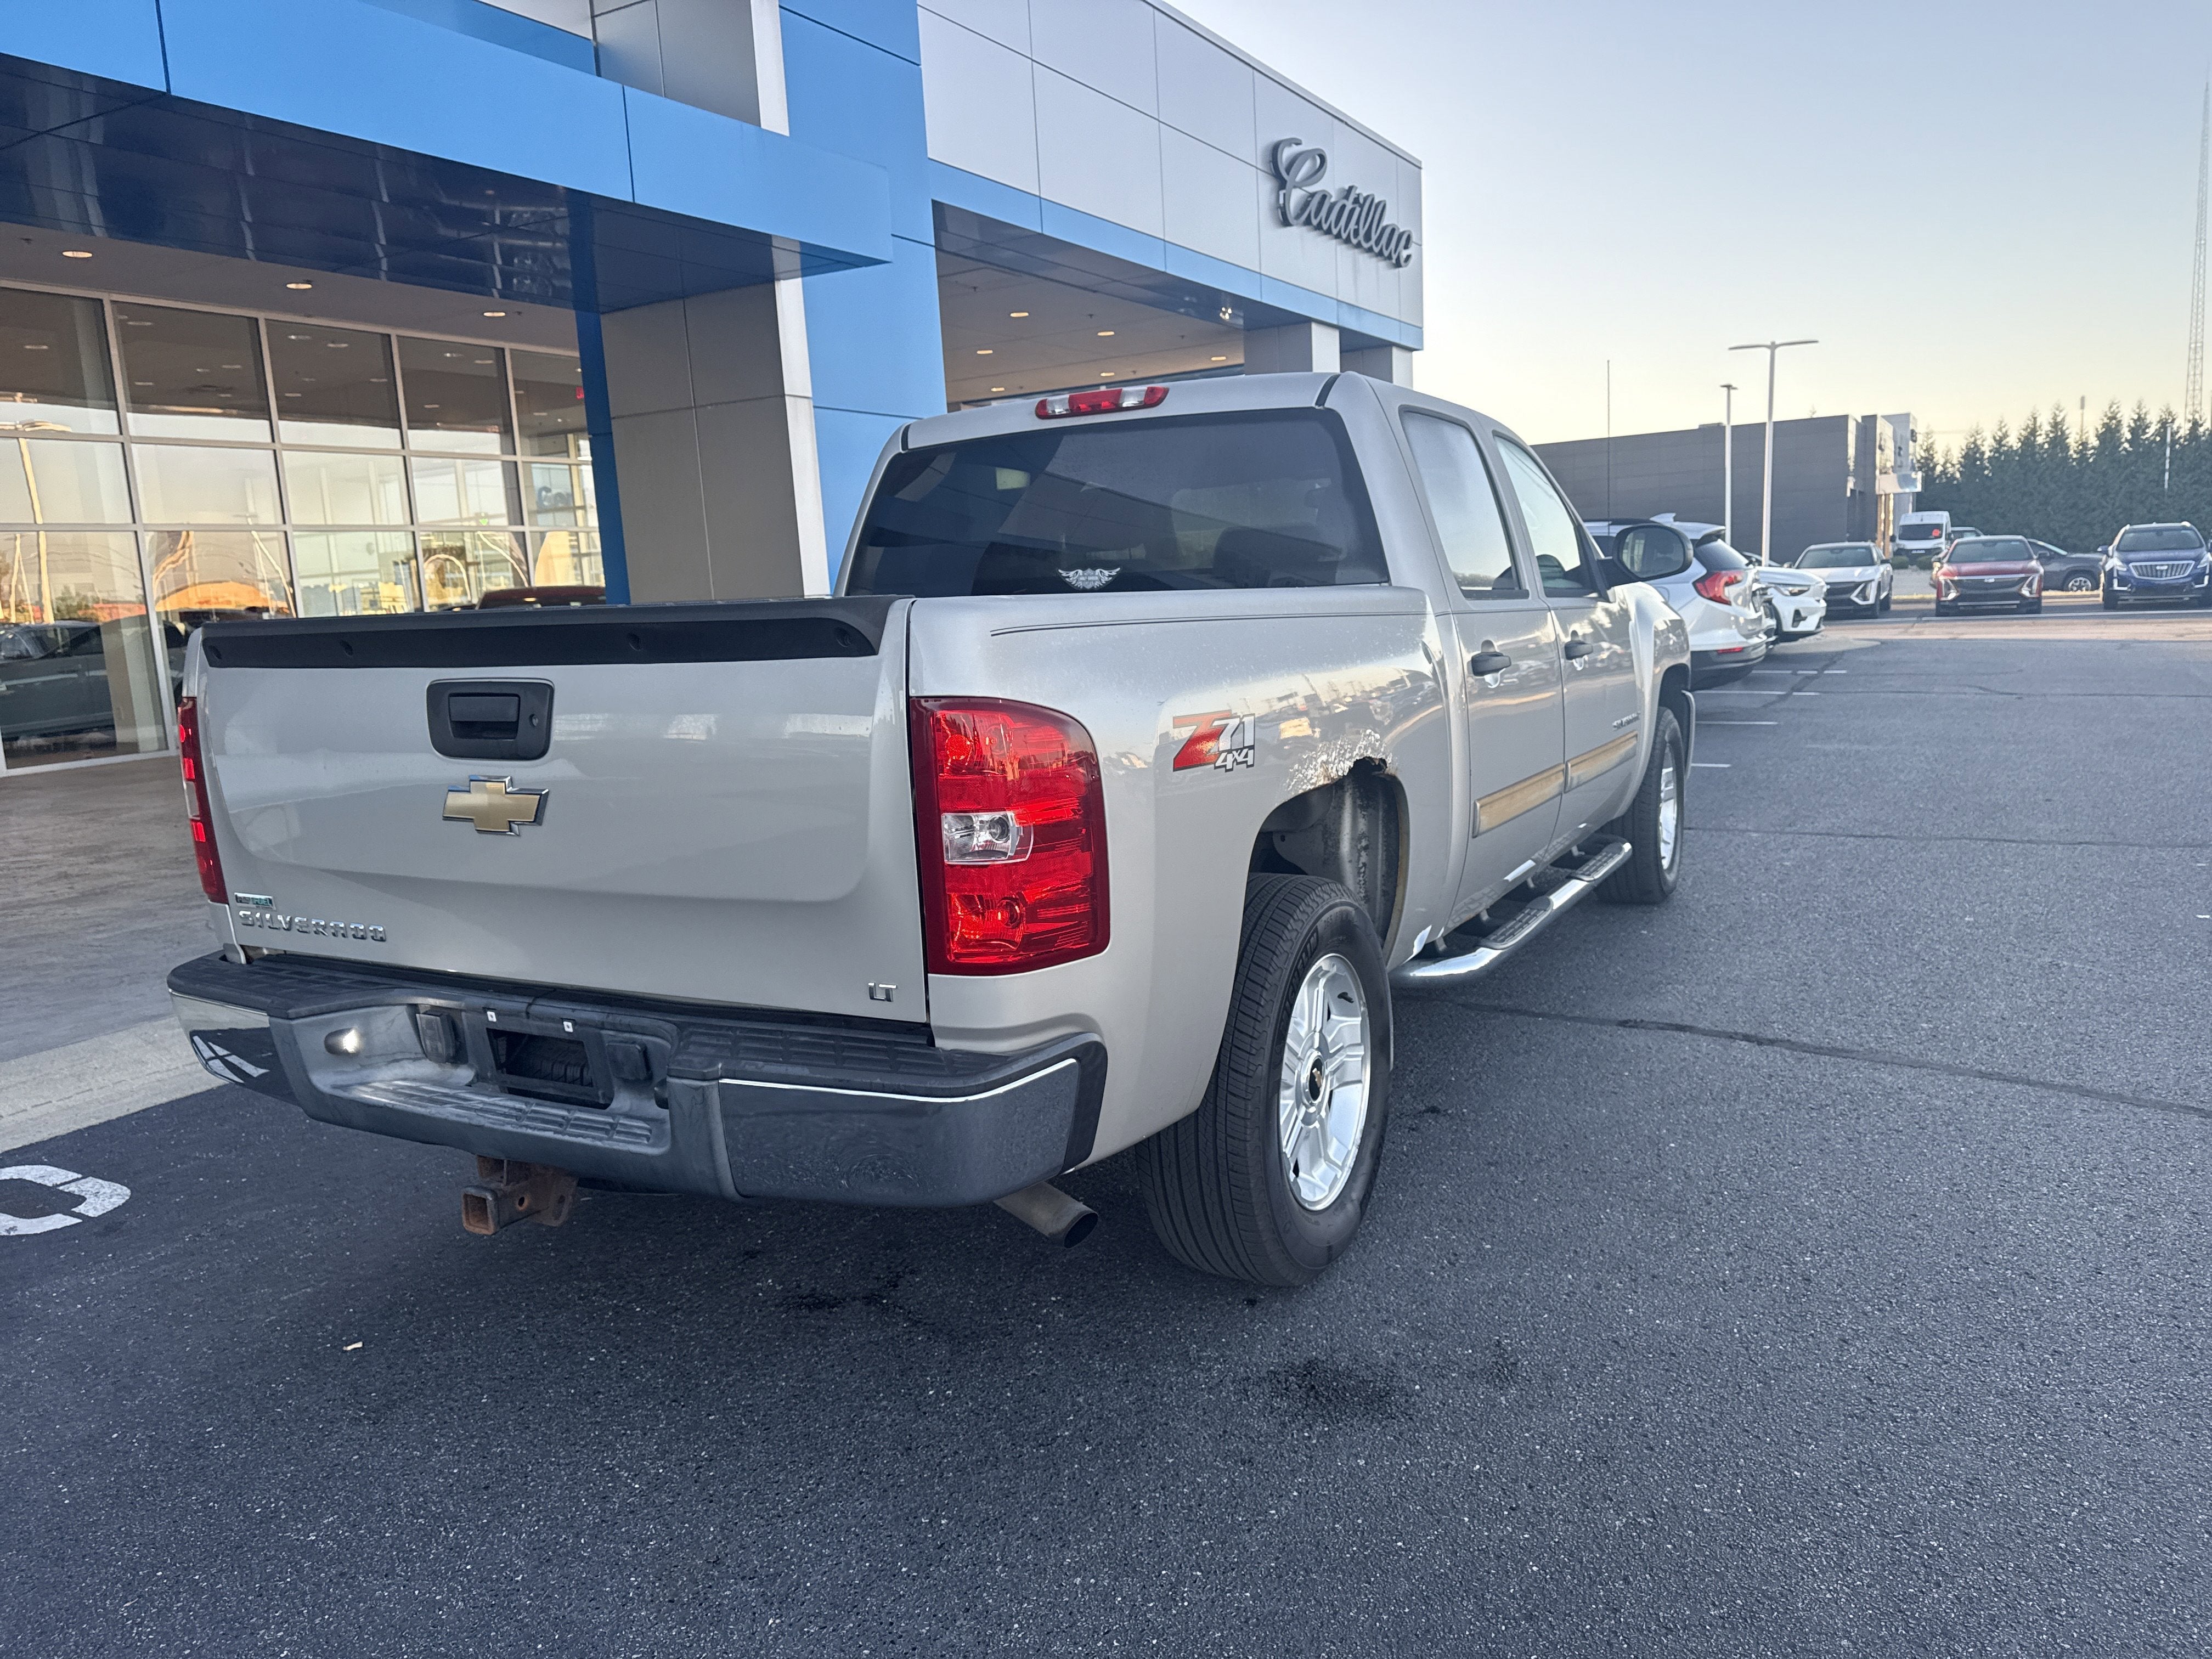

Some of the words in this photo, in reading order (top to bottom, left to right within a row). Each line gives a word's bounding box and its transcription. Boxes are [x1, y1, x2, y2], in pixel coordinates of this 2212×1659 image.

[1271, 137, 1413, 268] Cadillac
[1173, 709, 1255, 772] Z71
[239, 910, 386, 942] SILVERADO
[867, 981, 898, 1002] LT
